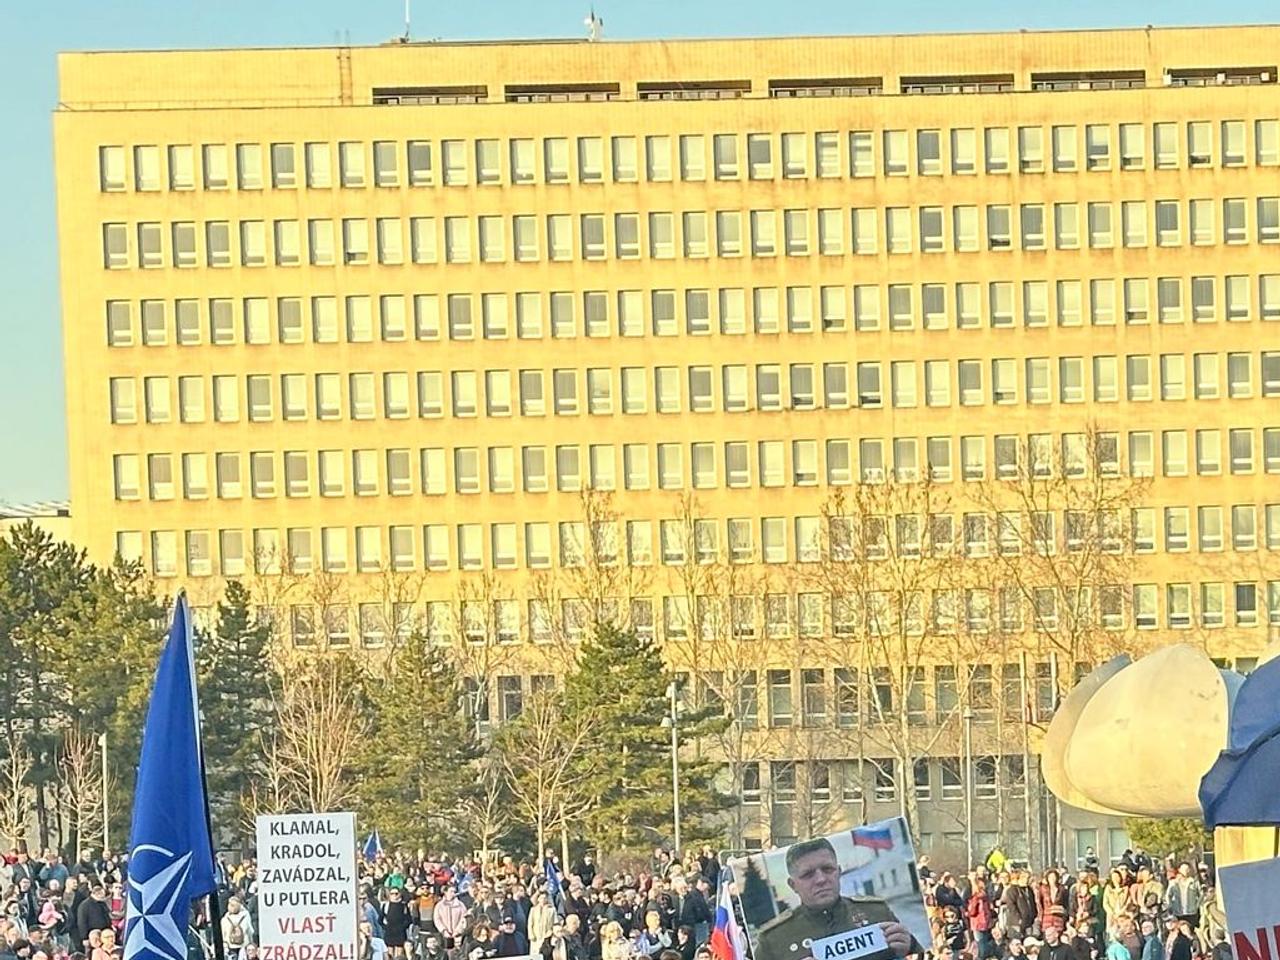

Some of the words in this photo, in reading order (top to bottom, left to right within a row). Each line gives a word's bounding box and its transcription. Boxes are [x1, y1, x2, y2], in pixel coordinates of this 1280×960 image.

[270, 820, 339, 836] KLAMAL,
[271, 843, 341, 859] KRADOL,
[262, 865, 350, 883] ZAVÁDZAL,
[264, 892, 274, 906] U
[279, 890, 350, 906] PUTLERA
[278, 913, 337, 934] VLASŤ
[825, 931, 874, 959] AGENT
